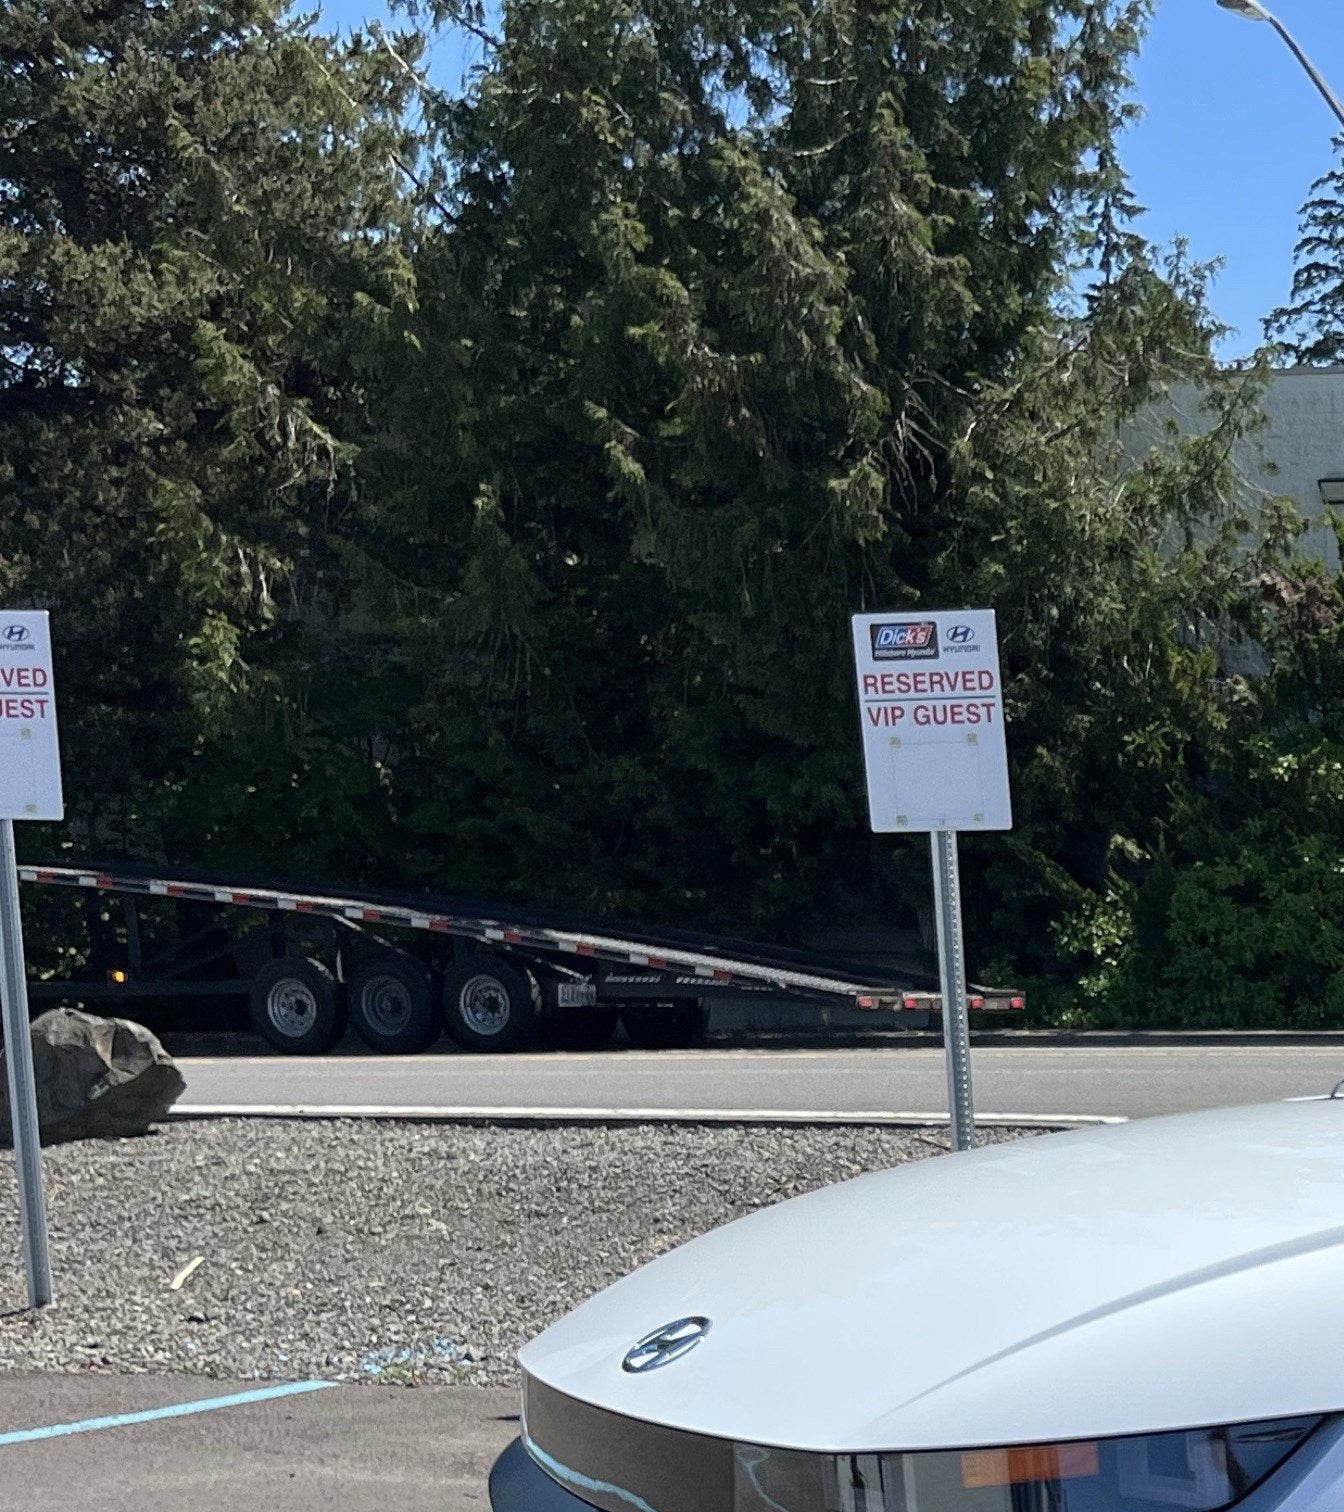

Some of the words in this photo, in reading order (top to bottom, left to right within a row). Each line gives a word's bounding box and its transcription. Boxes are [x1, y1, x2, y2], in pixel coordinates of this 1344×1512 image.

[863, 669, 994, 695] RESERVED
[867, 705, 905, 727] VIP
[913, 702, 996, 726] GUEST
